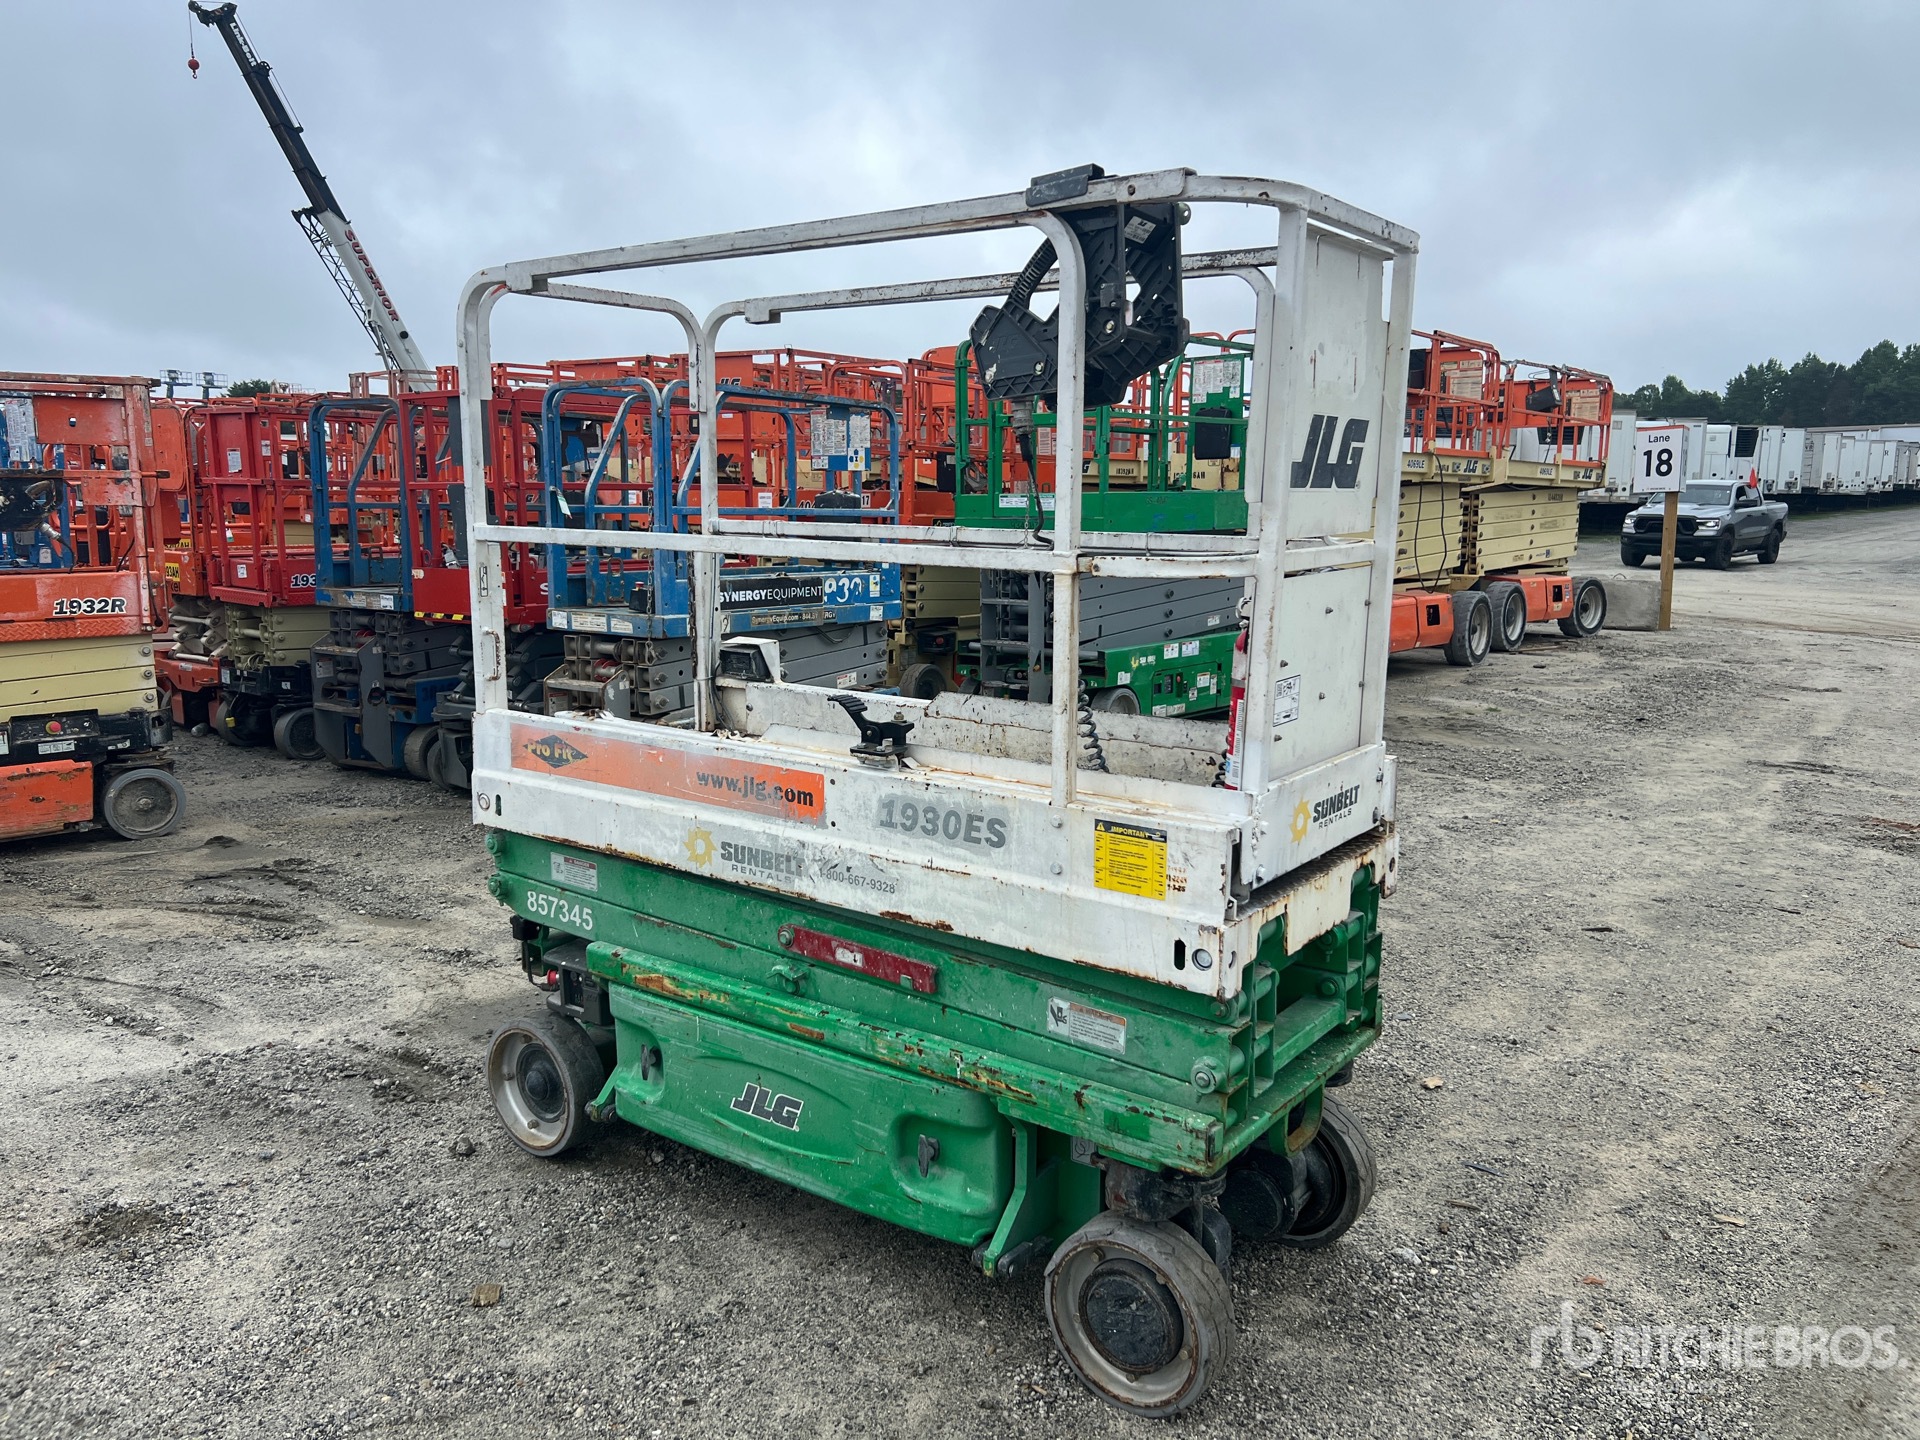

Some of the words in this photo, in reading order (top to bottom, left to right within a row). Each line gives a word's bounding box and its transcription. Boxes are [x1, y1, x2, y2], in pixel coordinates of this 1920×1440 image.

[345, 229, 400, 322] SUPERIOR
[1290, 414, 1370, 489] JLG
[1649, 435, 1671, 443] Lane
[1643, 448, 1673, 477] 18
[53, 597, 127, 616] 1932R
[527, 739, 550, 757] Pro
[696, 770, 813, 807] www.jlg.com
[1313, 784, 1360, 823] SUNBELT
[880, 799, 1007, 849] 1930ES
[1111, 826, 1149, 838] IMPORTANT
[1318, 808, 1352, 829] RENTALS
[721, 841, 804, 877] SUNBELT
[731, 863, 793, 884] RENTALS
[527, 890, 593, 931] 857345
[730, 1082, 804, 1131] JLG
